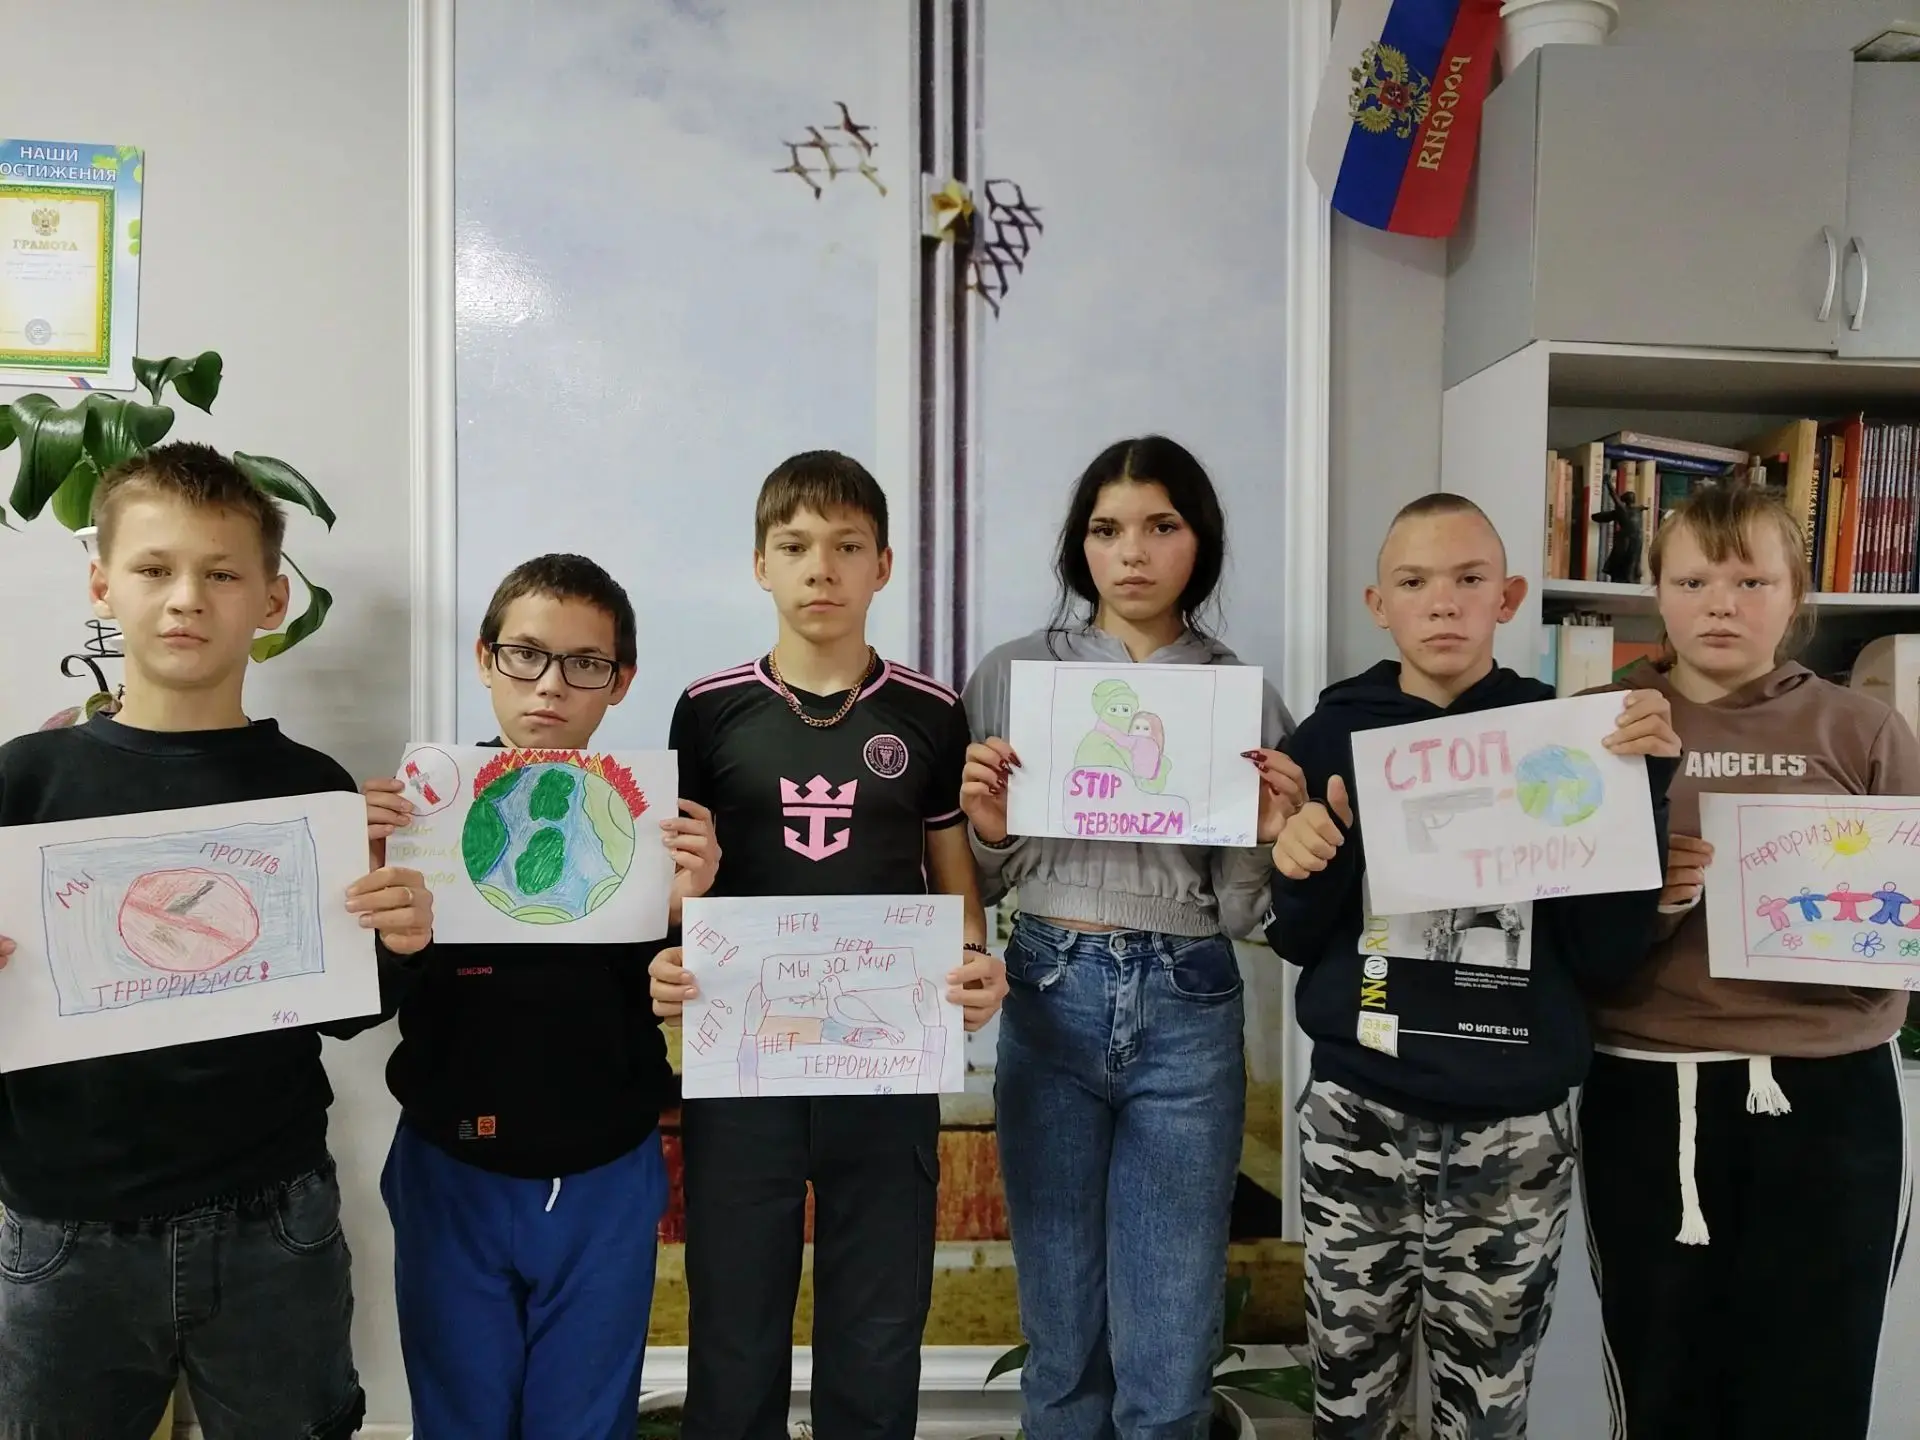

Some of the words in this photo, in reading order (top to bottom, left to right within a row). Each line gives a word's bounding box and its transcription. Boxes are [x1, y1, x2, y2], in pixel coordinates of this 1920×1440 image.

[20, 146, 78, 162] НАШИ
[0, 162, 117, 182] ОСТИЖЕНИЯ
[13, 239, 78, 252] ГРАМОТА
[1384, 730, 1513, 791] СТОП
[1685, 751, 1807, 777] ANGELES
[1070, 769, 1122, 798] STOP
[1741, 819, 1865, 871] ТЕРРОРИЗМУ
[1887, 820, 1920, 847] НЕ
[200, 841, 280, 875] ПРОТИВ
[777, 912, 819, 937] НЕТ!
[884, 904, 936, 927] НЕТ!
[687, 920, 739, 967] НЕТ!
[687, 998, 733, 1056] НЕТ!
[1458, 1022, 1474, 1032] NO
[1512, 1027, 1529, 1037] U13
[762, 1032, 800, 1054] НЕТ
[798, 1055, 917, 1077] ТЕРРОРИЗМУ
